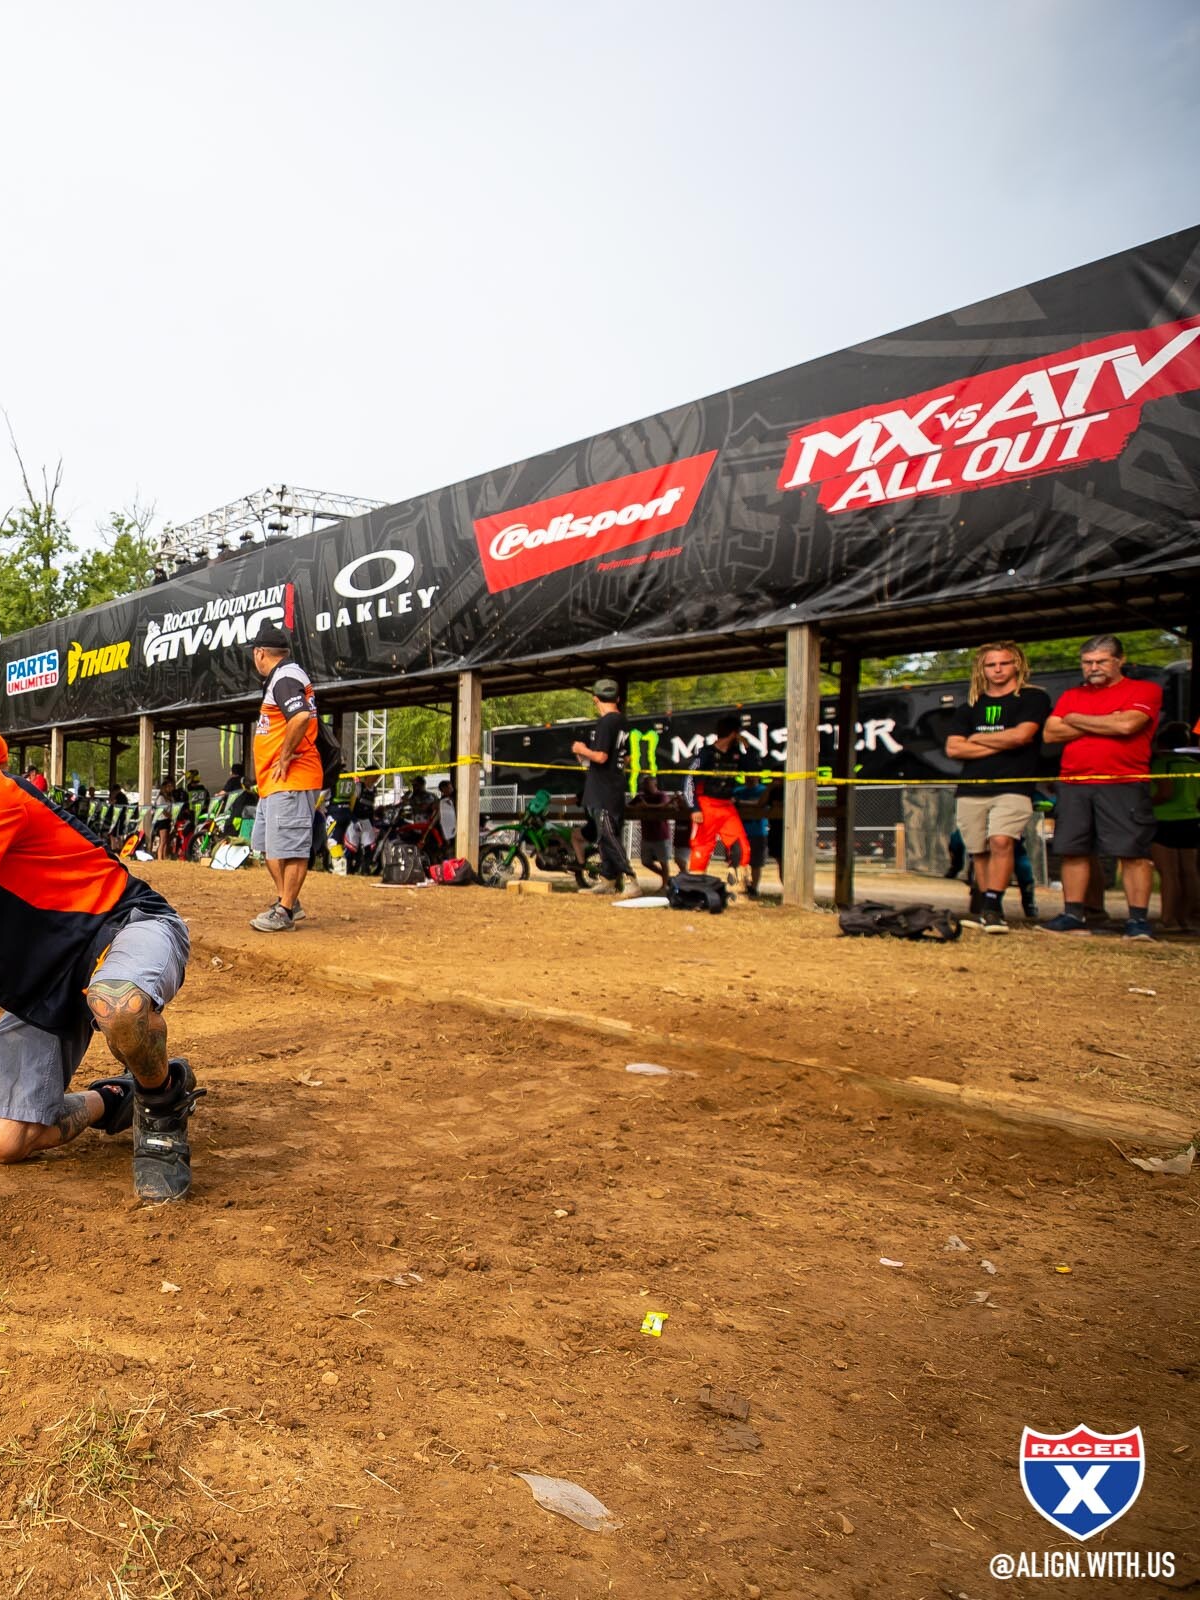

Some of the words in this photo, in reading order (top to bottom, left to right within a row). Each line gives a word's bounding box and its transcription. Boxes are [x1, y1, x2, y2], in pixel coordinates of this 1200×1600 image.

[784, 395, 956, 489] MX
[955, 326, 1200, 445] ATV
[827, 457, 953, 513] ALL
[961, 412, 1110, 482] OUT
[490, 487, 683, 560] Polisport
[161, 606, 204, 634] ROCKY
[203, 583, 286, 623] MOUNTAIN
[315, 586, 438, 632] OAKLEY
[7, 651, 58, 682] PARTS
[7, 671, 58, 694] UNLIMITED
[80, 640, 131, 679] THOR
